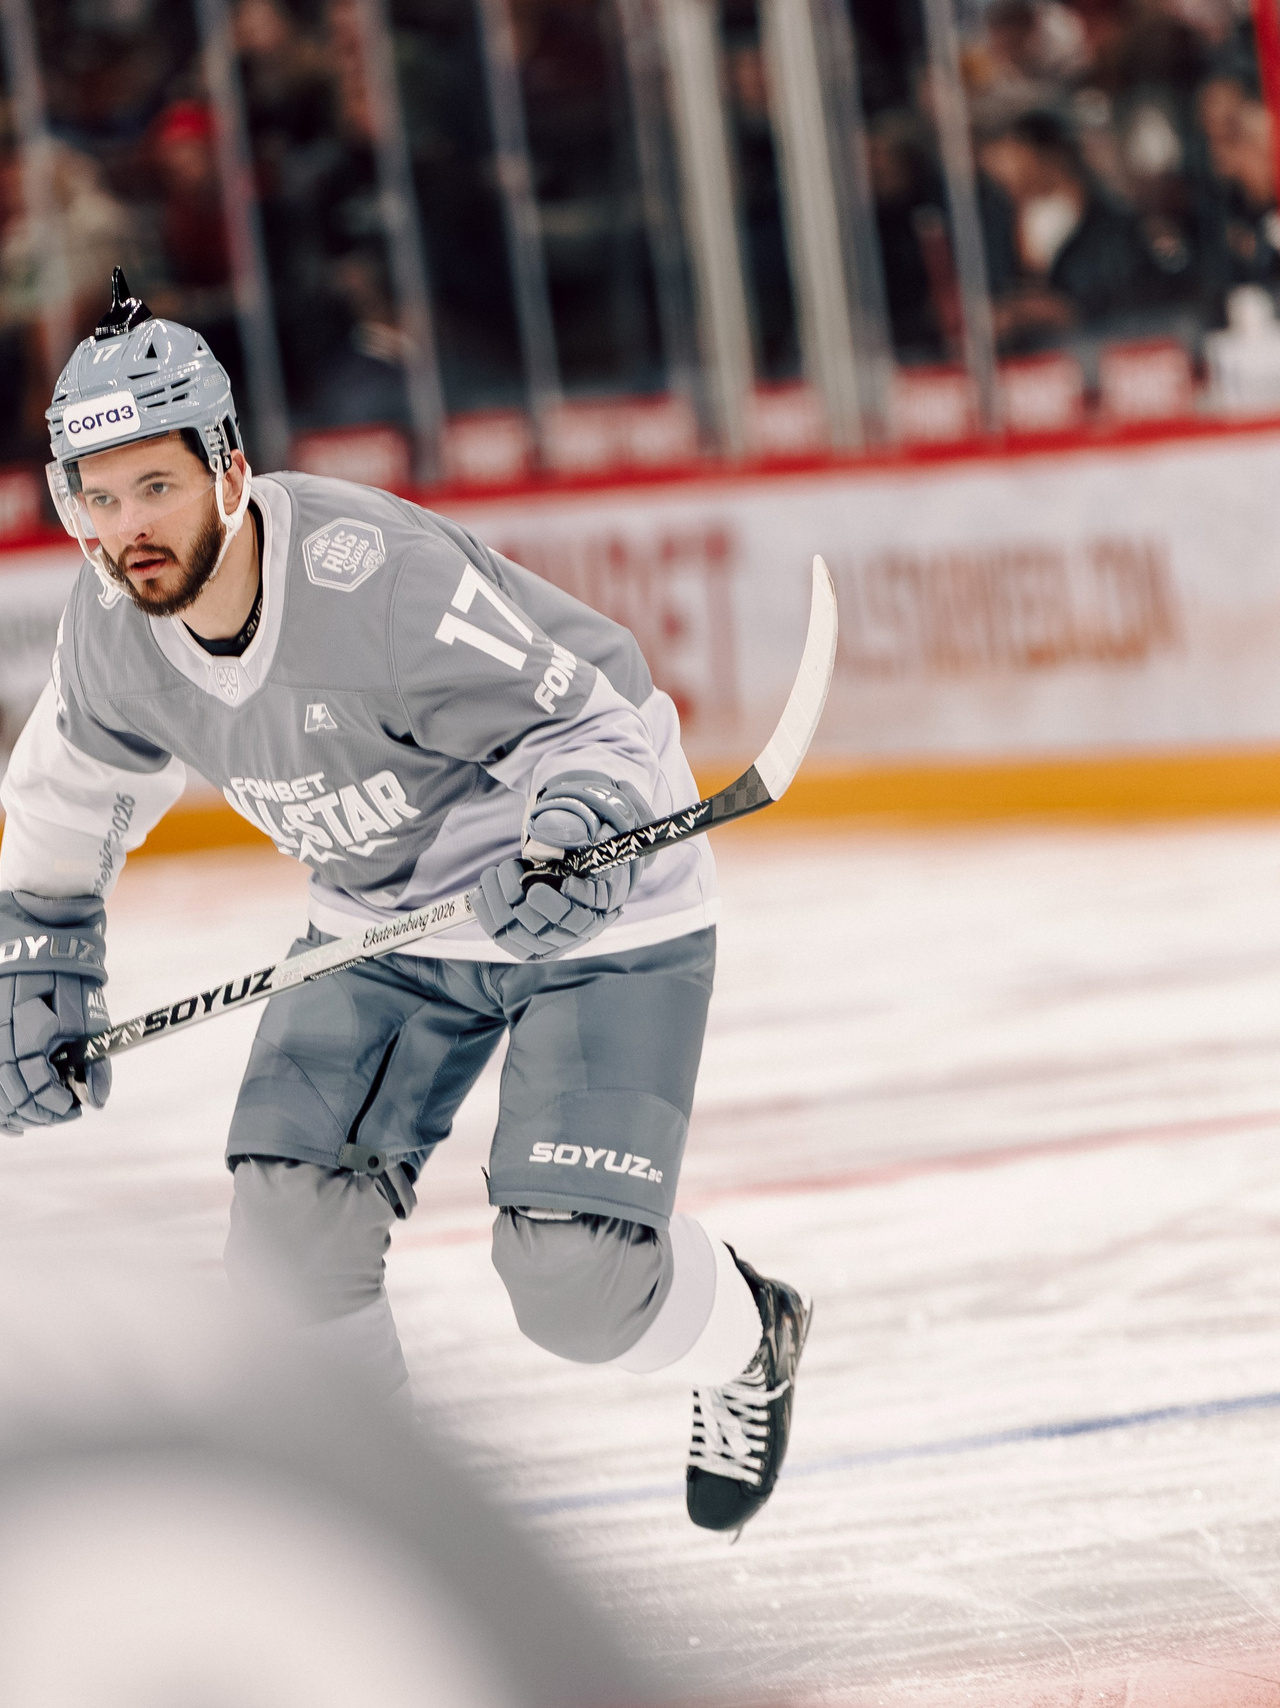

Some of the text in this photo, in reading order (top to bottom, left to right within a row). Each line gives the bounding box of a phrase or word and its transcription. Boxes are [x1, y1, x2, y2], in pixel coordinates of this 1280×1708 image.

[93, 342, 122, 365] 17
[67, 405, 134, 434] согаз
[311, 536, 331, 558] KHL
[321, 530, 358, 574] RUS
[342, 539, 370, 575] Stars
[434, 563, 534, 671] 17
[534, 642, 577, 715] FON
[230, 771, 325, 803] FONBET
[362, 901, 456, 949] Ekaterinburg 2026
[142, 966, 277, 1037] SOYUZ
[529, 1141, 651, 1179] SOYUZ
